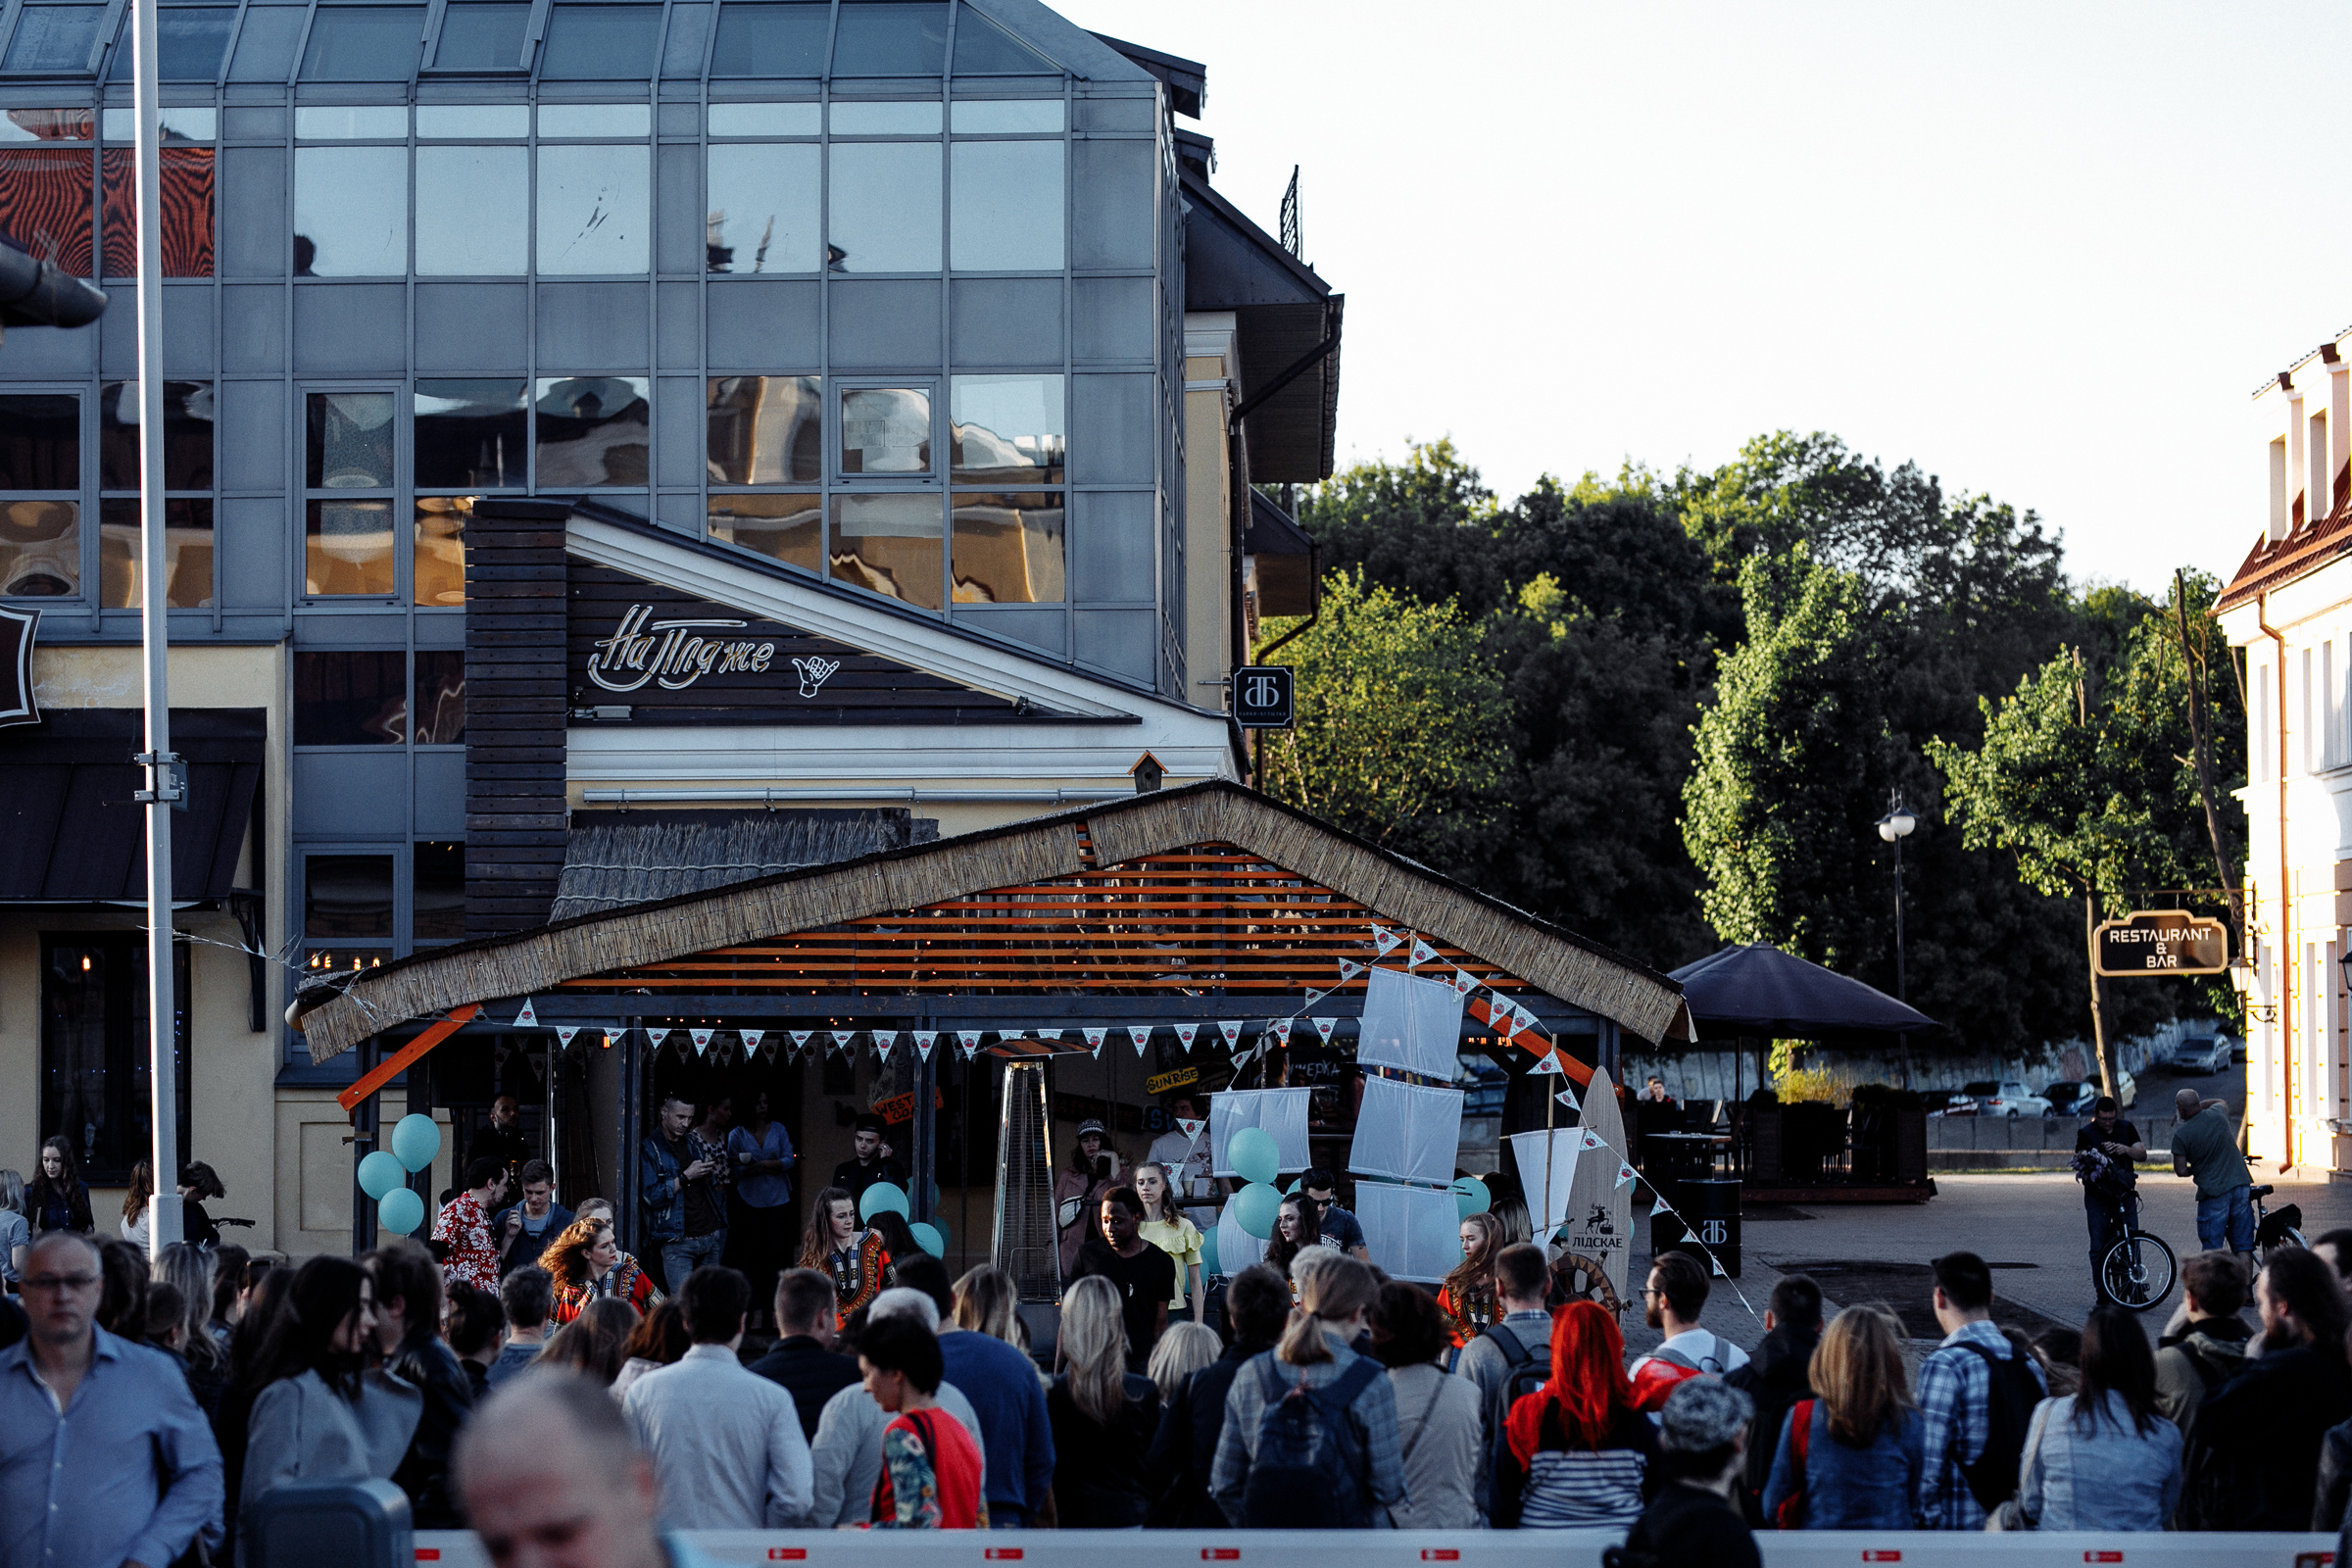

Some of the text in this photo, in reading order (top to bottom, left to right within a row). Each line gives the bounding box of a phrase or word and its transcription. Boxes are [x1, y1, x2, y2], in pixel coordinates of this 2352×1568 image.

[2109, 927, 2212, 943] RESTAURANT
[2155, 943, 2167, 955] &
[2146, 955, 2178, 968] BAR
[875, 1095, 912, 1115] WEST
[1572, 1237, 1623, 1249] ЛІДСКАЕ
